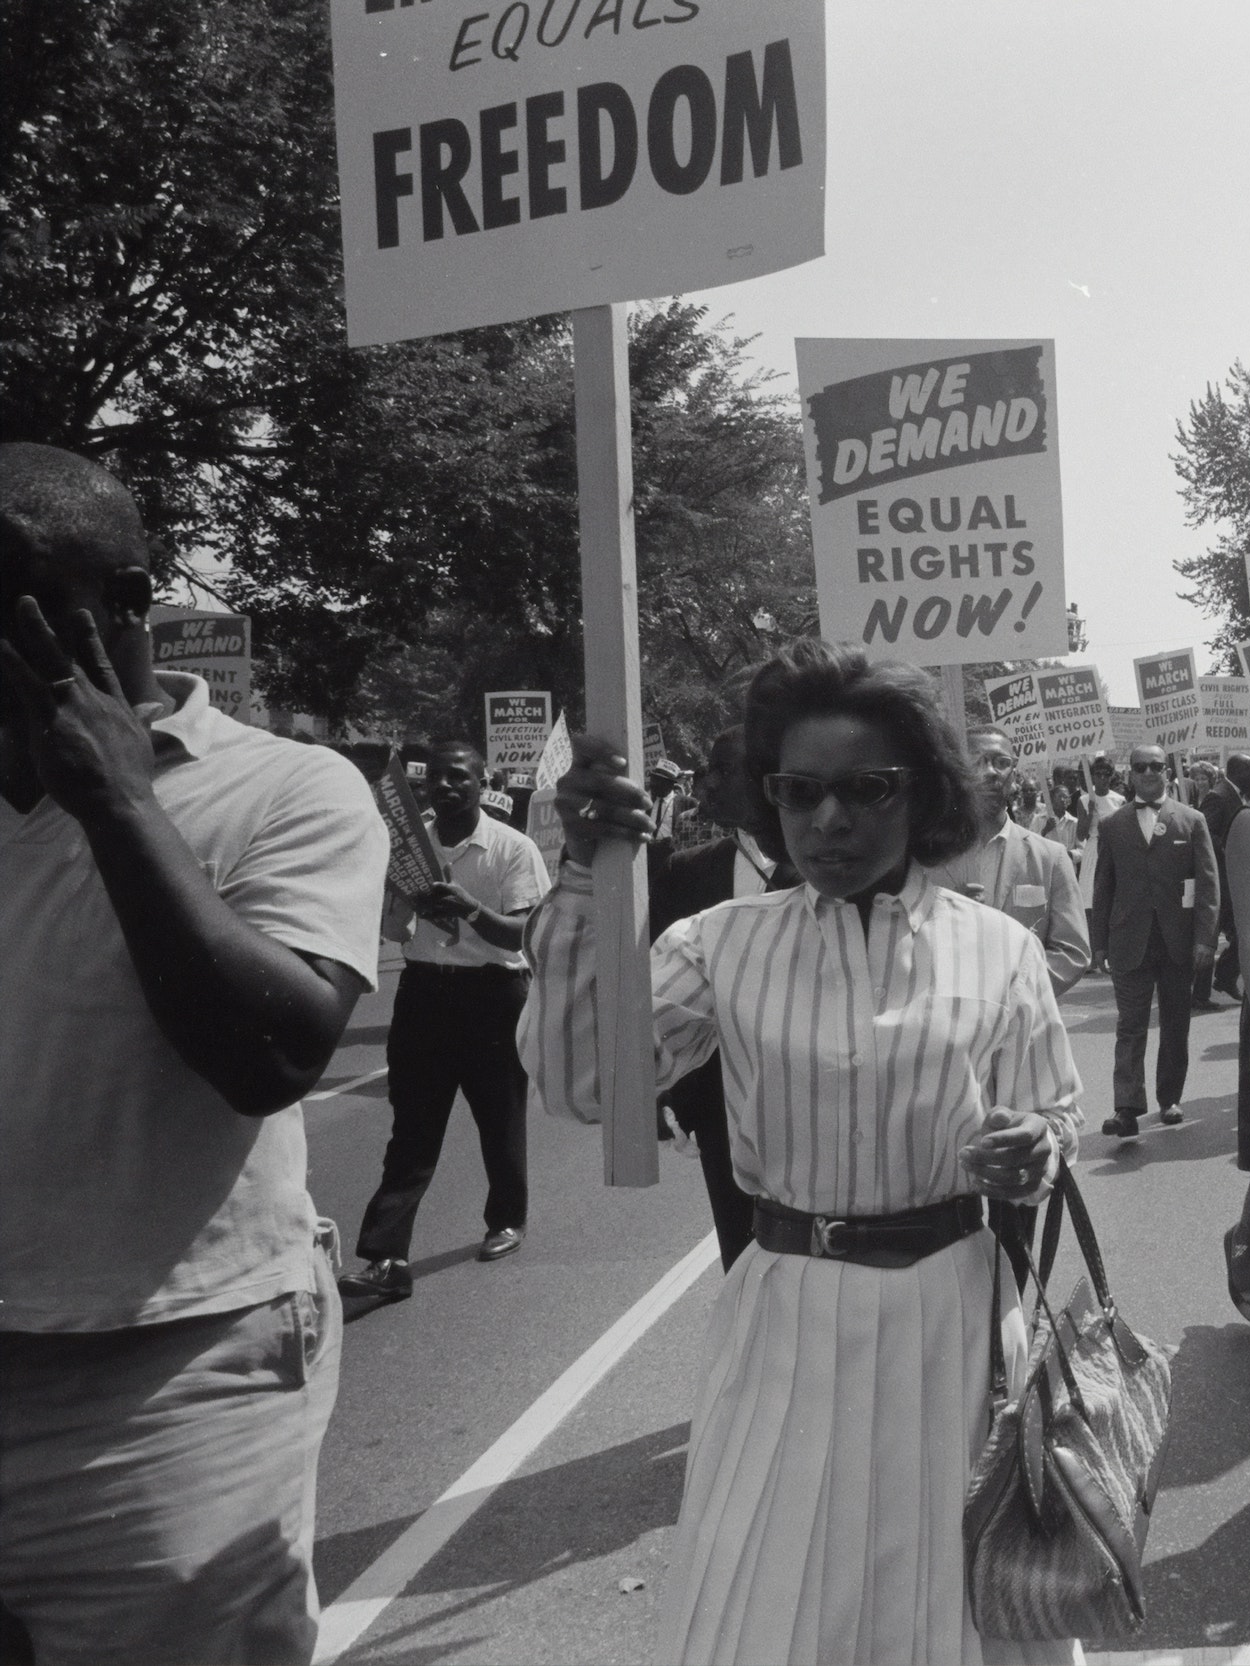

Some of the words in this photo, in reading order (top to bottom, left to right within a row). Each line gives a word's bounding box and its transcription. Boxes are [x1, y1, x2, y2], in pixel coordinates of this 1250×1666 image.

[373, 37, 803, 249] FREEDOM
[889, 363, 970, 420] WE
[833, 398, 1038, 485] DEMAND
[857, 494, 1027, 535] EQUAL
[857, 540, 1036, 583] RIGHTS
[863, 580, 1044, 645] NOW!
[181, 620, 216, 638] WE
[159, 635, 242, 659] DEMAND
[1158, 661, 1173, 672] WE
[1009, 678, 1030, 696] WE
[1058, 674, 1075, 685] WE
[1146, 669, 1189, 689] MARCH
[1045, 682, 1093, 699] MARCH
[1160, 685, 1177, 694] FOR
[1200, 684, 1219, 692] CIVIL
[1222, 684, 1249, 693] RIGHTS
[494, 707, 542, 717] MARCH
[1045, 703, 1102, 721] INTEGRATED
[1144, 701, 1170, 716] FIRST
[1171, 694, 1197, 709] CLASS
[1214, 700, 1234, 708] FULL
[1004, 715, 1021, 726] AN
[1048, 717, 1105, 735] SCHOOLS
[1145, 706, 1200, 729] CITIZENSHIP
[495, 726, 544, 734] EFFECTIVE
[1015, 723, 1043, 735] POLICE
[1156, 722, 1198, 747] NOW!
[1206, 726, 1248, 738] REEDOM
[1057, 729, 1104, 752] NOW!
[495, 750, 544, 763] NOW!
[380, 774, 410, 827] MARCH
